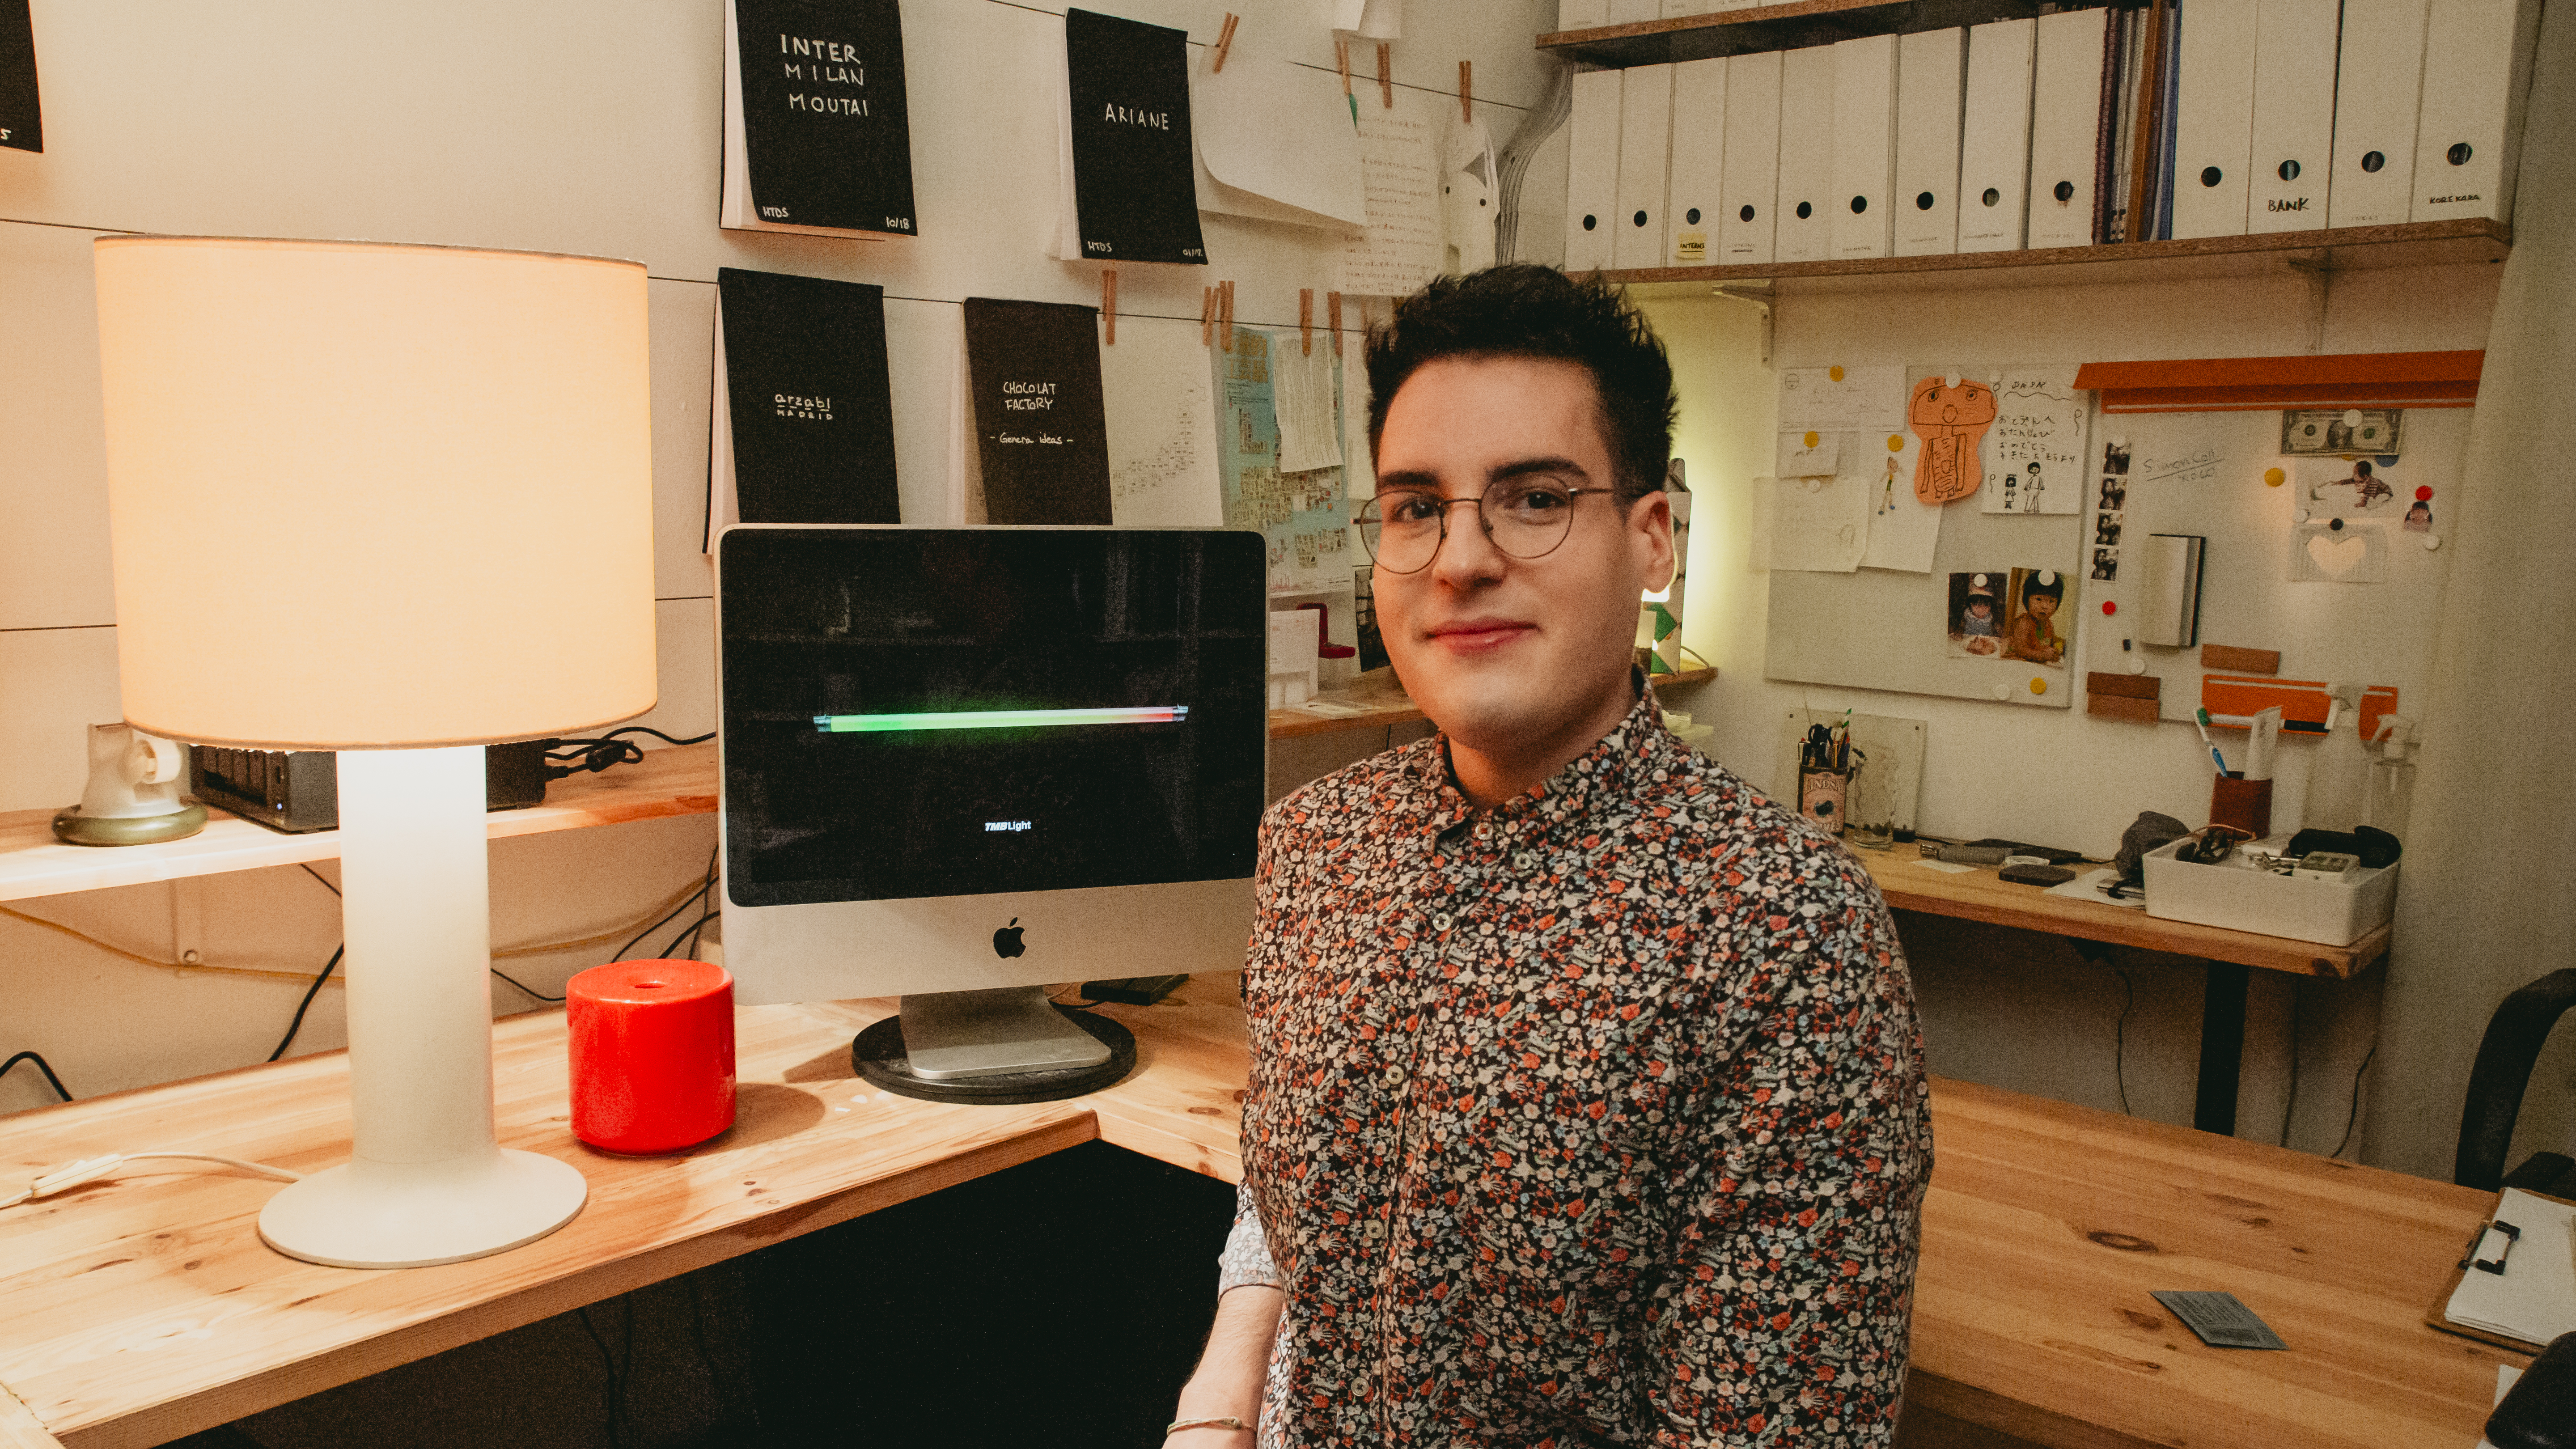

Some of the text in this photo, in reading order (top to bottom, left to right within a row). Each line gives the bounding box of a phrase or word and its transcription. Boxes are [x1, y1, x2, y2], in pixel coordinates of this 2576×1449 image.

[781, 34, 861, 64] INTER
[785, 64, 864, 86] MILAN
[789, 93, 868, 116] MOUTAI
[1105, 103, 1169, 130] ARIANE
[762, 205, 789, 218] HTDS
[2268, 198, 2309, 212] BANK
[886, 216, 910, 229] 10/18
[1087, 241, 1112, 253] HTDS
[1003, 381, 1056, 395] CHOCOLAT
[1005, 397, 1053, 411] FACTORY
[776, 409, 833, 420] MADRID
